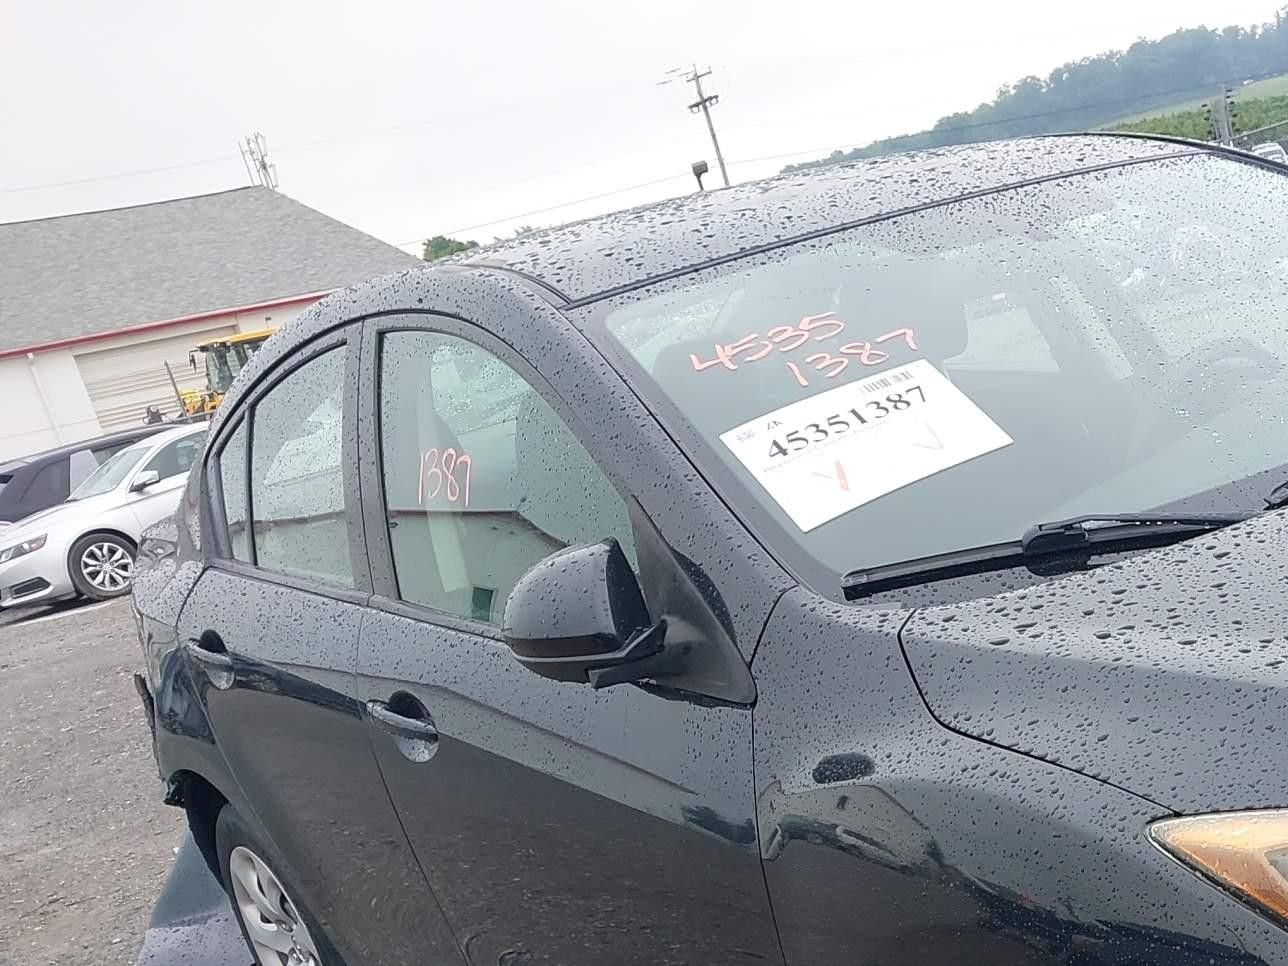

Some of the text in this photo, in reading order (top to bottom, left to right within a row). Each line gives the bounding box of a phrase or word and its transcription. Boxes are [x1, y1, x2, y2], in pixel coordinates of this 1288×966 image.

[690, 311, 845, 371] 4535
[787, 328, 919, 387] 1387
[767, 385, 928, 458] 45351387
[418, 448, 472, 507] 1387
